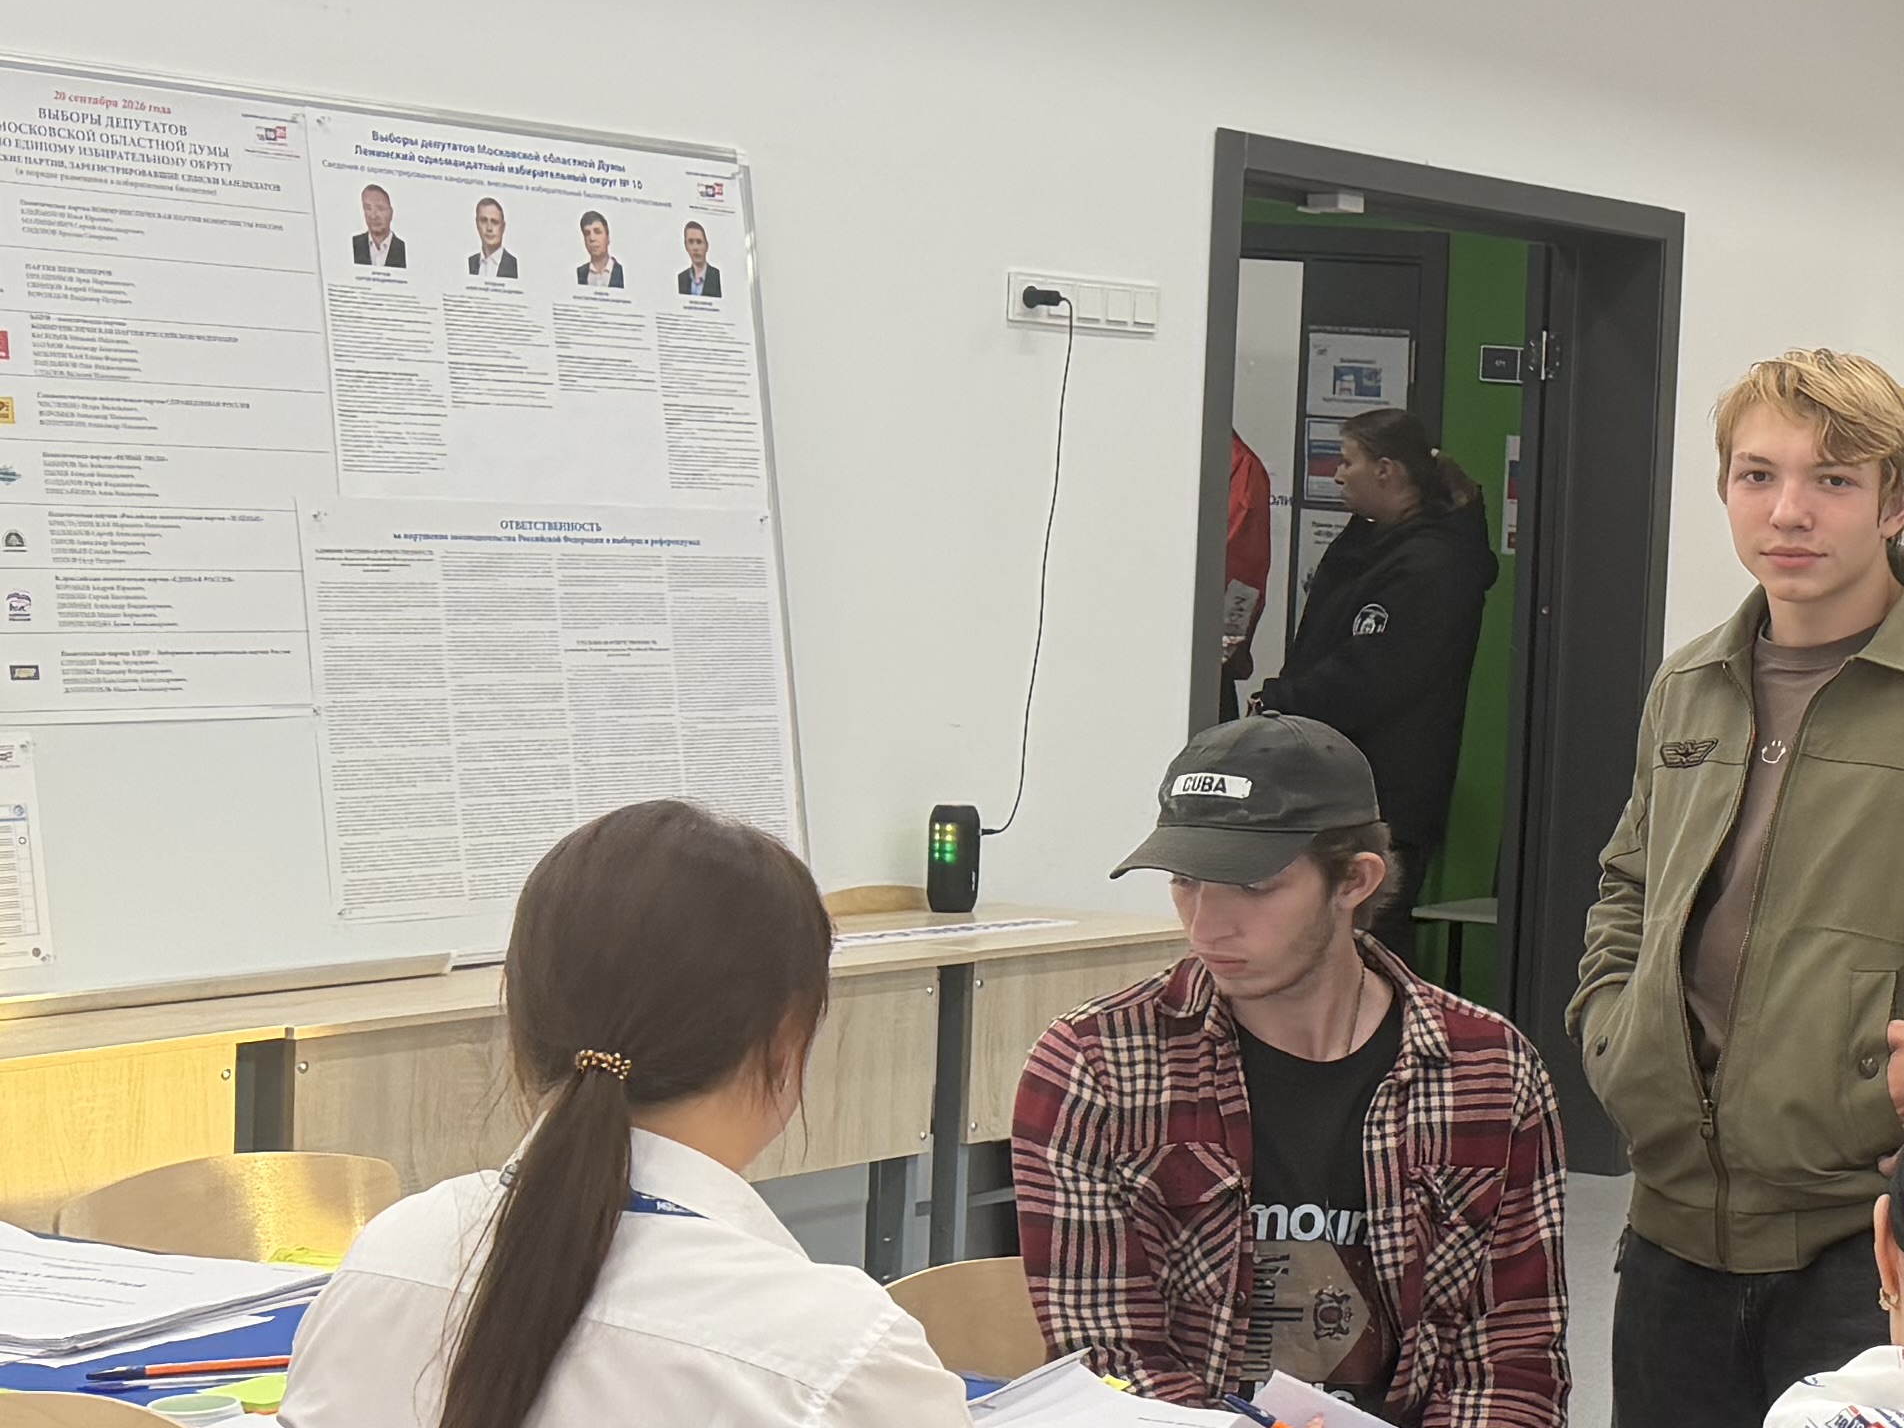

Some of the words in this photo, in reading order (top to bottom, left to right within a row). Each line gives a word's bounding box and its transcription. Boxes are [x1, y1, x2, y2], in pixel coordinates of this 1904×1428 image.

[68, 92, 119, 109] сентября
[121, 99, 147, 112] 2026
[38, 107, 101, 127] ВЫБОРЫ
[104, 116, 188, 137] ДЕПУТАТОВ
[15, 139, 75, 156] ЕДИНОМУ
[78, 145, 187, 168] ИЗБИРАТЕЛЬНОМУ
[189, 158, 233, 173] ОКРУГУ
[99, 132, 185, 153] ОБЛАСТНОЙ
[188, 142, 230, 159] ДУМЫ
[371, 130, 419, 149] Выборы
[420, 138, 475, 157] депутатов
[500, 519, 602, 533] ОТВЕТСТВЕННОСТЬ
[1182, 775, 1228, 794] CUBA
